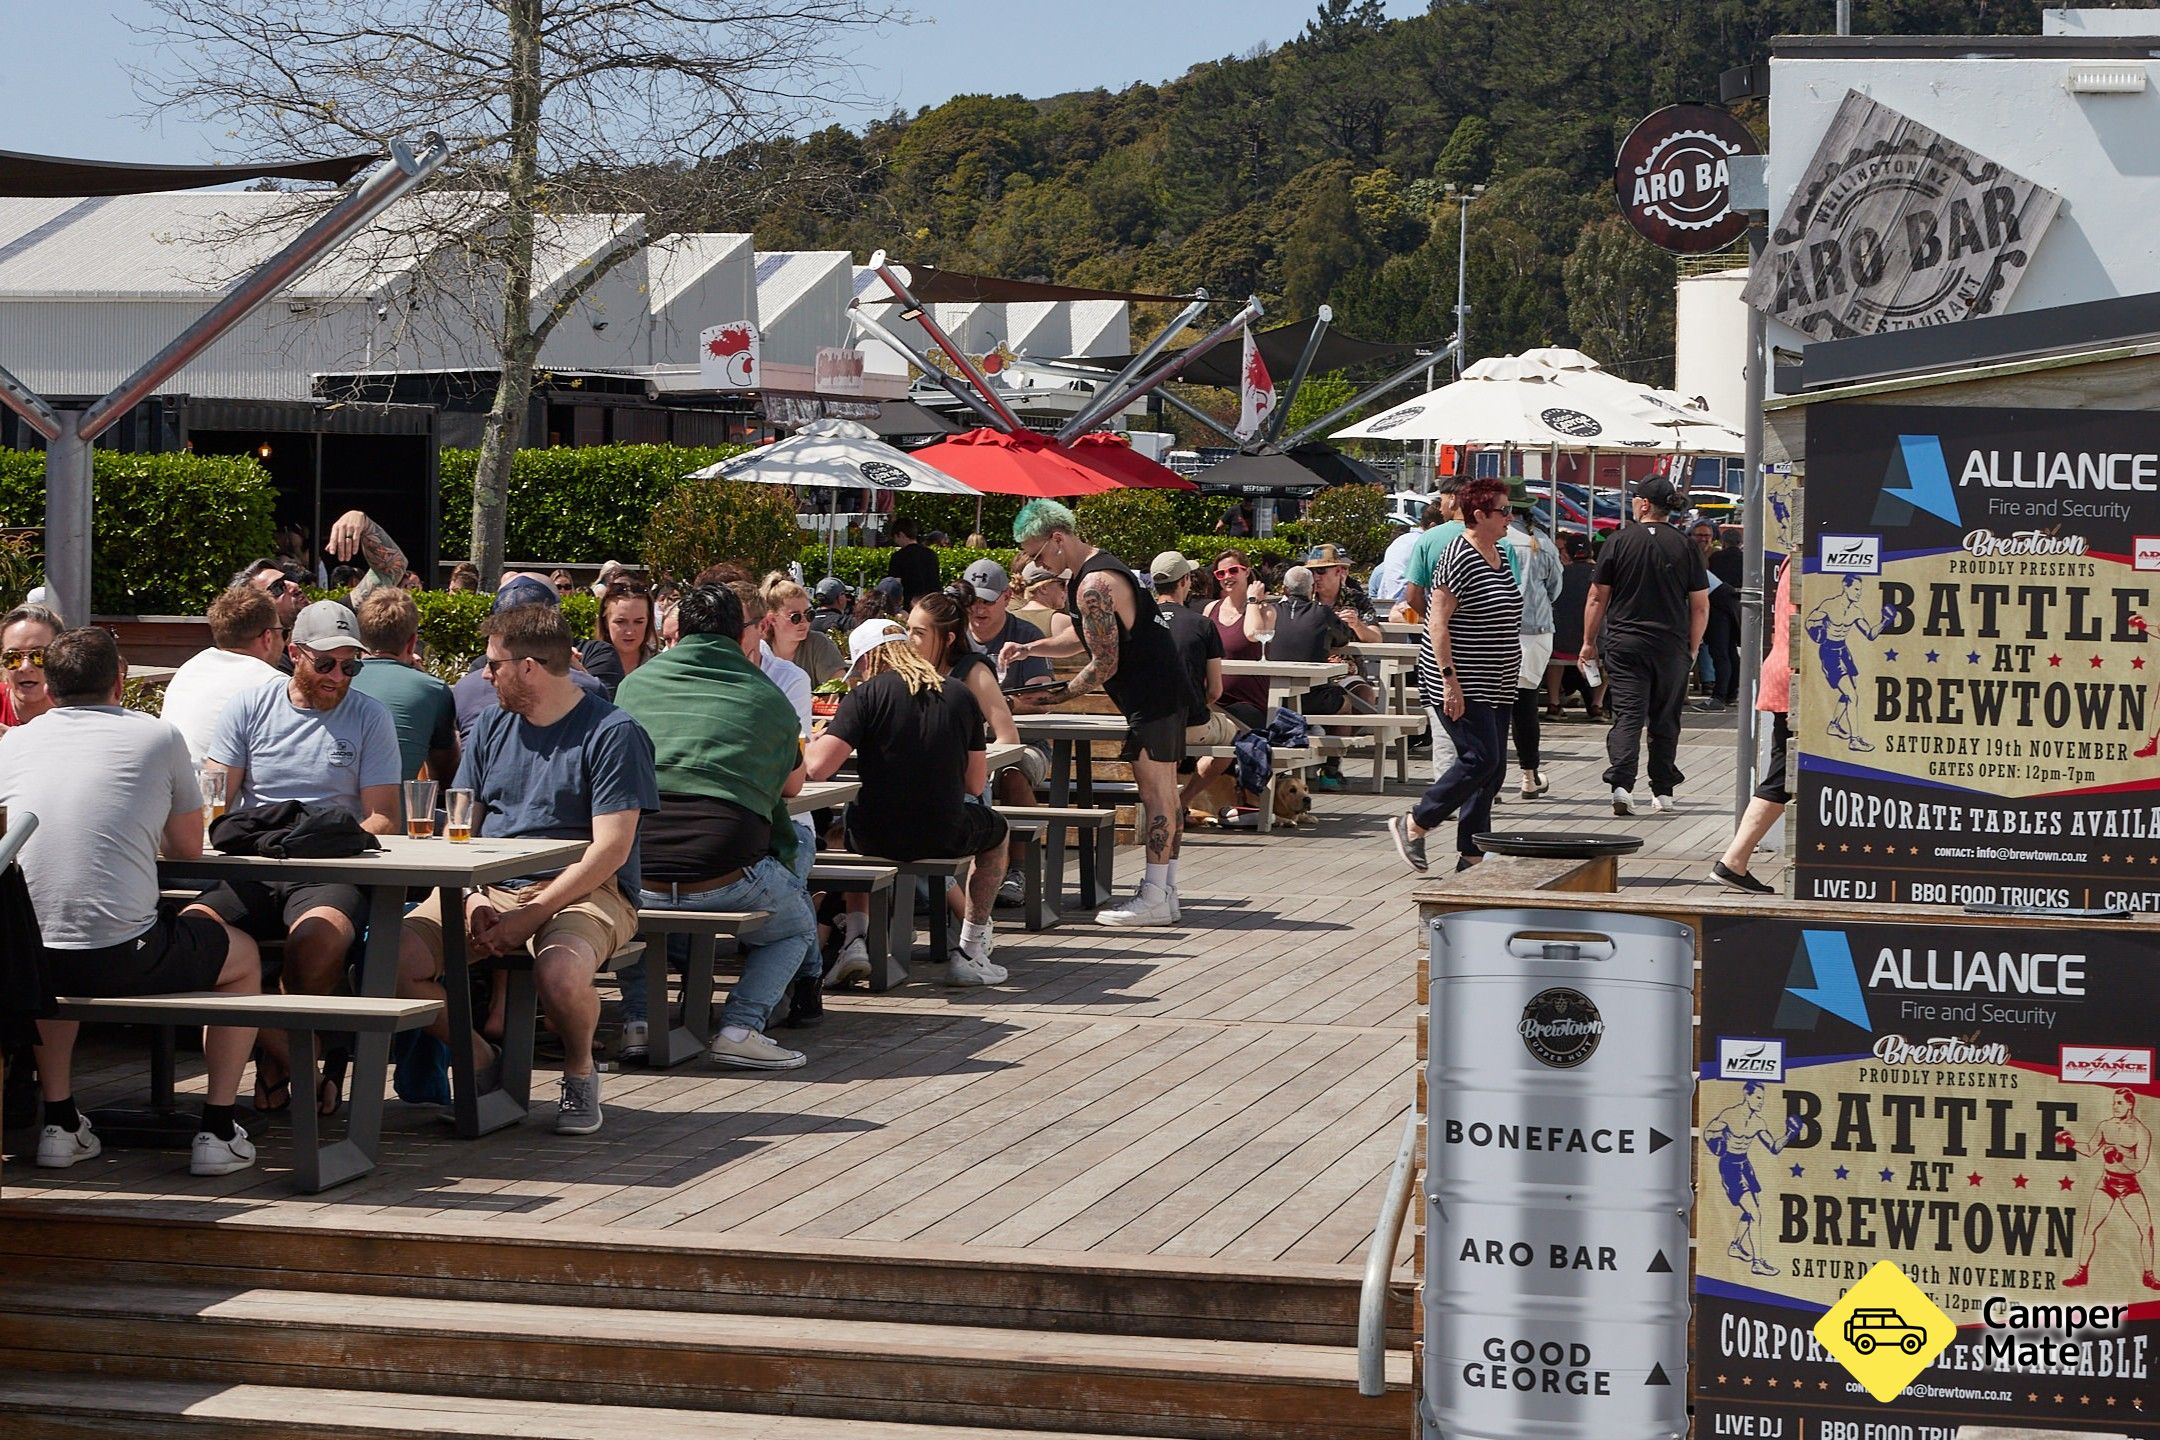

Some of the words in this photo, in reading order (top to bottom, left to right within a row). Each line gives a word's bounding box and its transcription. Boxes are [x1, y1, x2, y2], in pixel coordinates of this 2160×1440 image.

[1632, 168, 1685, 206] ARO
[1695, 159, 1730, 193] BA
[1815, 160, 1918, 224] WELLINGTON
[1927, 166, 1951, 187] NZ
[1774, 227, 1884, 314] ARO
[1905, 186, 2022, 272] BAR
[1959, 449, 2158, 491] ALLIANCE
[1989, 498, 2020, 516] Fire
[2025, 498, 2058, 517] and
[2063, 499, 2131, 522] Security
[1962, 528, 2089, 558] Brewtown
[1827, 553, 1874, 565] NZCIS
[1950, 560, 2014, 576] PROUDLY
[2020, 561, 2095, 577] PRESENTS
[1879, 581, 2149, 643] BATTLE
[1992, 644, 2035, 673] AT
[1874, 676, 2147, 731] BREWTOWN
[1886, 735, 1980, 756] SATURDAY
[1987, 738, 2022, 757] 19th
[2029, 740, 2129, 761] NOVEMBER
[1929, 761, 1974, 777] GATES
[1979, 763, 2021, 779] OPEN:
[2026, 765, 2095, 782] 12pm-7pm
[1819, 786, 1963, 832] CORPORATE
[1970, 808, 2062, 836] TABLES
[1934, 846, 1975, 859] CONTACT:
[1976, 846, 2088, 863] info@brewtown.co.nz
[1813, 879, 1851, 899] LIVE
[1855, 880, 1877, 900] DJ
[1911, 882, 1947, 904] BBQ
[1951, 884, 1997, 906] FOOD
[2001, 886, 2070, 908] TRUCKS
[2104, 890, 2160, 912] CRAFT
[1868, 947, 2086, 996] ALLIANCE
[1517, 1018, 1605, 1039] Brewtown
[1901, 1000, 1938, 1021] Fire
[1941, 1001, 1977, 1022] and
[1982, 1002, 2057, 1029] Security
[1532, 1041, 1563, 1062] UPPER
[1568, 1041, 1592, 1061] HUTT
[1726, 1058, 1777, 1071] NZCIS
[1872, 1034, 2010, 1065] Brewtown
[1859, 1067, 1930, 1085] PROUDLY
[1936, 1070, 2018, 1090] PRESENTS
[2065, 1061, 2148, 1070] ADVANCE
[1446, 1120, 1635, 1154] BONEFACE
[1782, 1090, 2079, 1162] BATTLE
[1906, 1161, 1955, 1192] AT
[1779, 1193, 2077, 1259] BREWTOWN
[1459, 1238, 1534, 1266] ARO
[1549, 1245, 1618, 1271] BAR
[1792, 1258, 1877, 1281] SATURD
[1948, 1266, 2057, 1291] NOVEMBER
[1483, 1337, 1591, 1368] GOOD
[1720, 1312, 1839, 1364] CORPOR
[1463, 1362, 1611, 1396] GEORGE
[1715, 1413, 1754, 1436] LIVE
[1759, 1416, 1782, 1439] DJ
[1821, 1420, 1860, 1440] BBQ
[1864, 1423, 1913, 1440] FOOD
[1918, 1426, 1956, 1440] TRU
